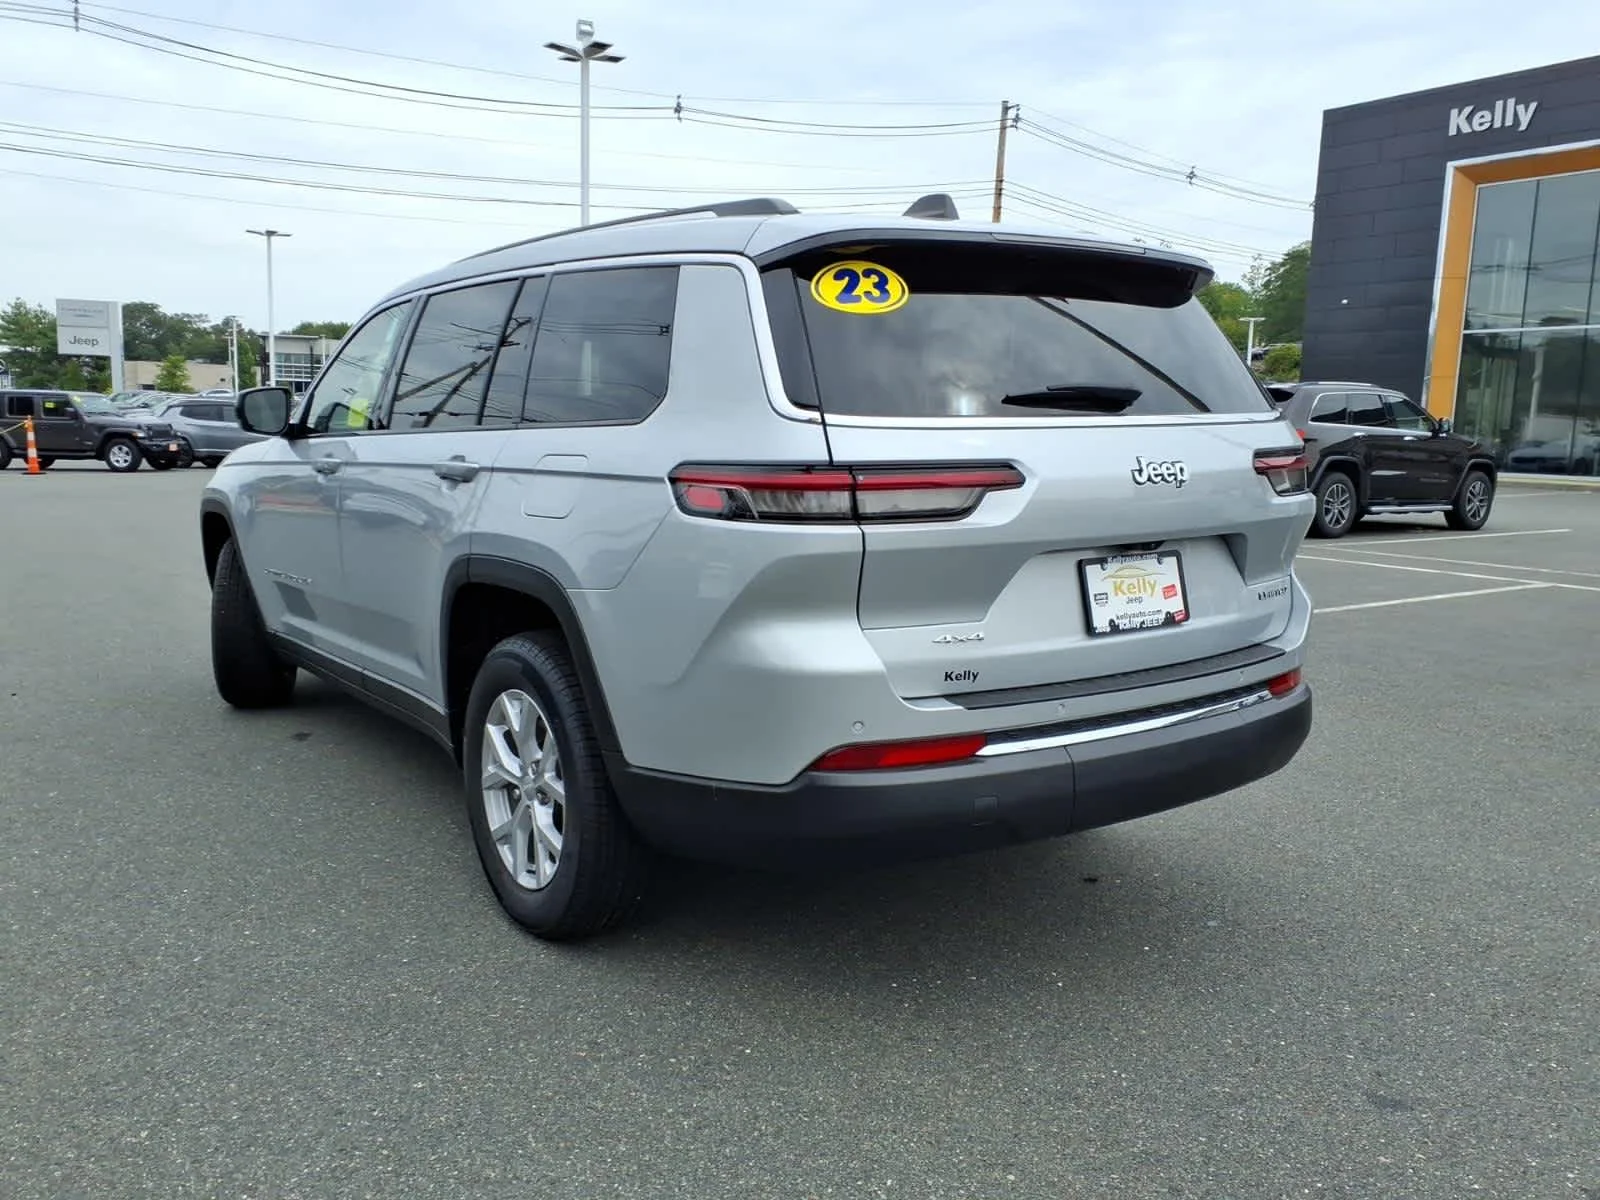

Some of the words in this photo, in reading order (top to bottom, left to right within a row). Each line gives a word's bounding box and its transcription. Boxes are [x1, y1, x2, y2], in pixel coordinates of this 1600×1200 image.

[1448, 97, 1538, 136] Kelly
[833, 267, 891, 304] 23
[69, 335, 100, 348] Jeep
[1130, 455, 1188, 489] Jeep
[1112, 577, 1157, 597] Kelly
[1126, 595, 1143, 605] Jeep
[1115, 608, 1162, 622] kellyauto.com
[932, 632, 984, 643] 4x4
[944, 670, 980, 683] Kelly
